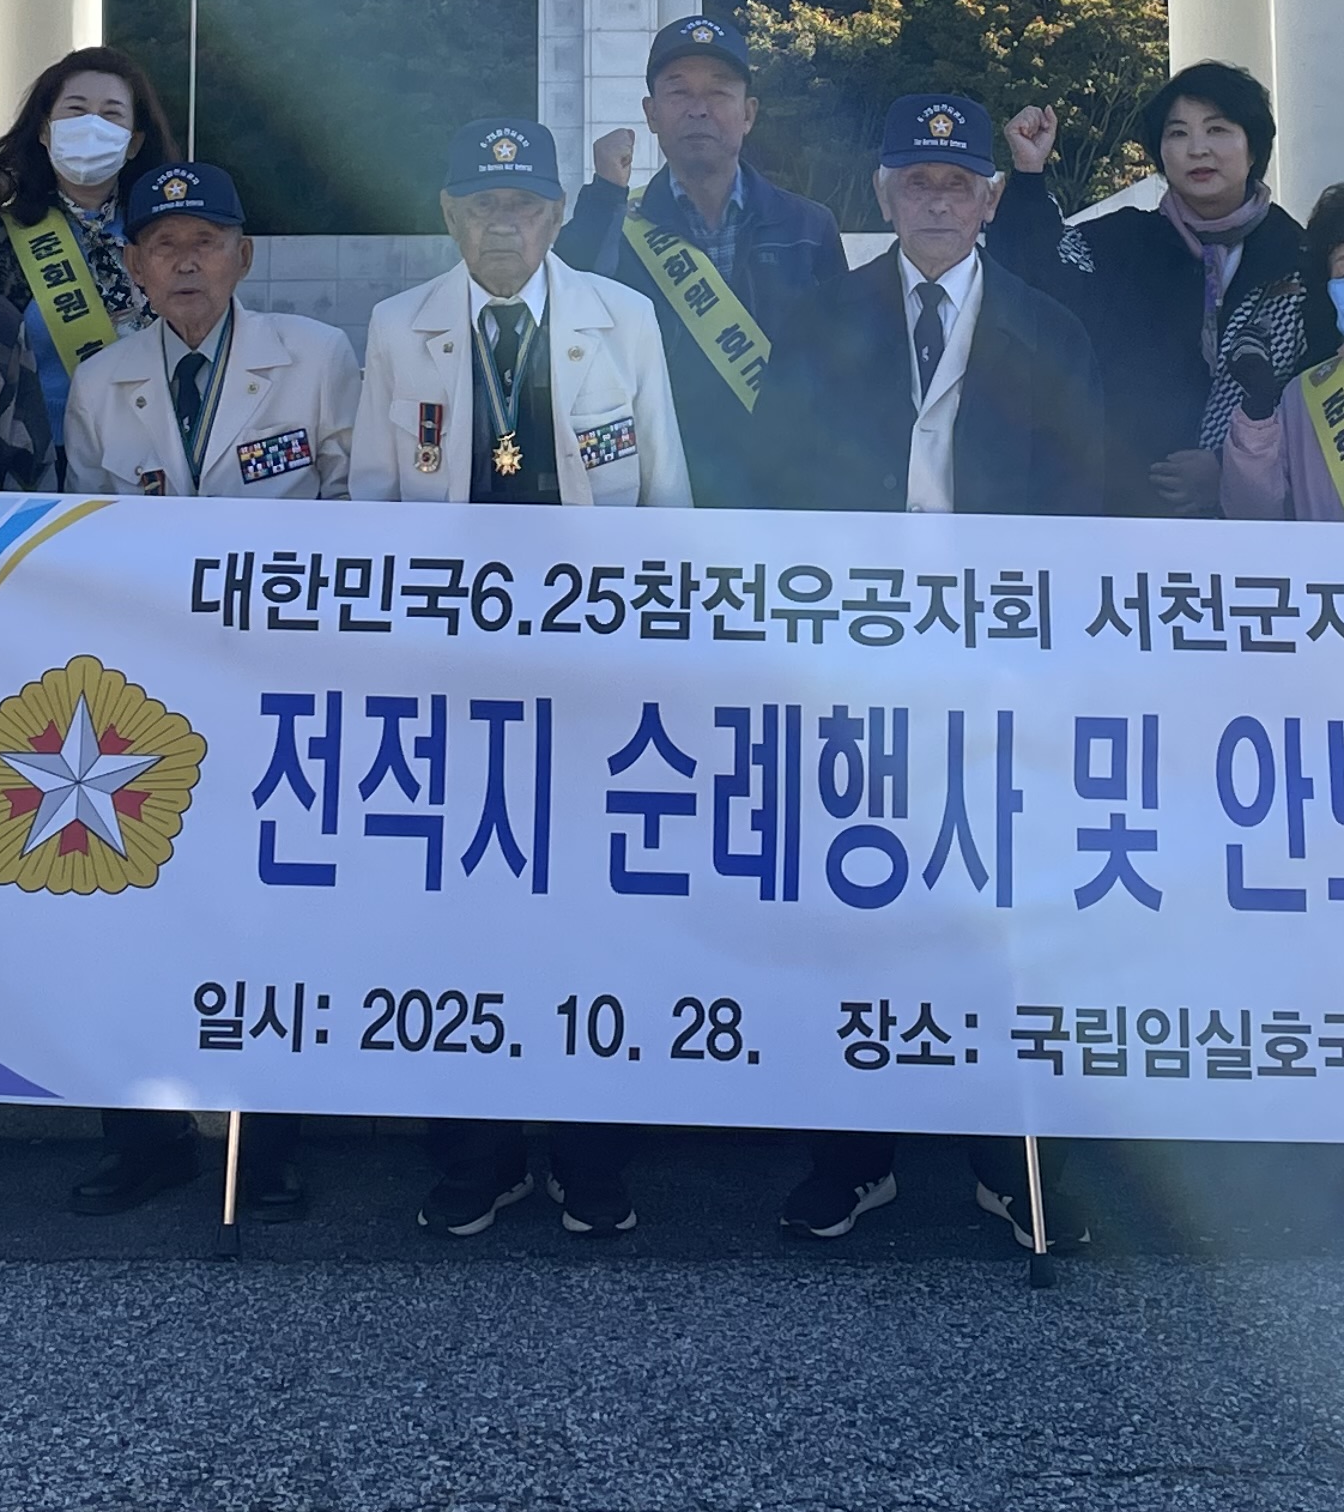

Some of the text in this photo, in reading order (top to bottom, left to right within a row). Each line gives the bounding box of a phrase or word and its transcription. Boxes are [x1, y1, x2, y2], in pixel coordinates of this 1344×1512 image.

[28, 231, 90, 323] 준회원
[191, 551, 1053, 650] 대한민국6.25참전유공자회
[251, 690, 553, 896] 전적지
[605, 701, 1024, 911] 순례행사
[1073, 716, 1164, 913] 및
[193, 981, 331, 1053] 일시:
[360, 987, 523, 1058] 2025.
[556, 994, 642, 1062] 10.
[670, 996, 761, 1066] 28.
[836, 998, 979, 1072] 장소:
